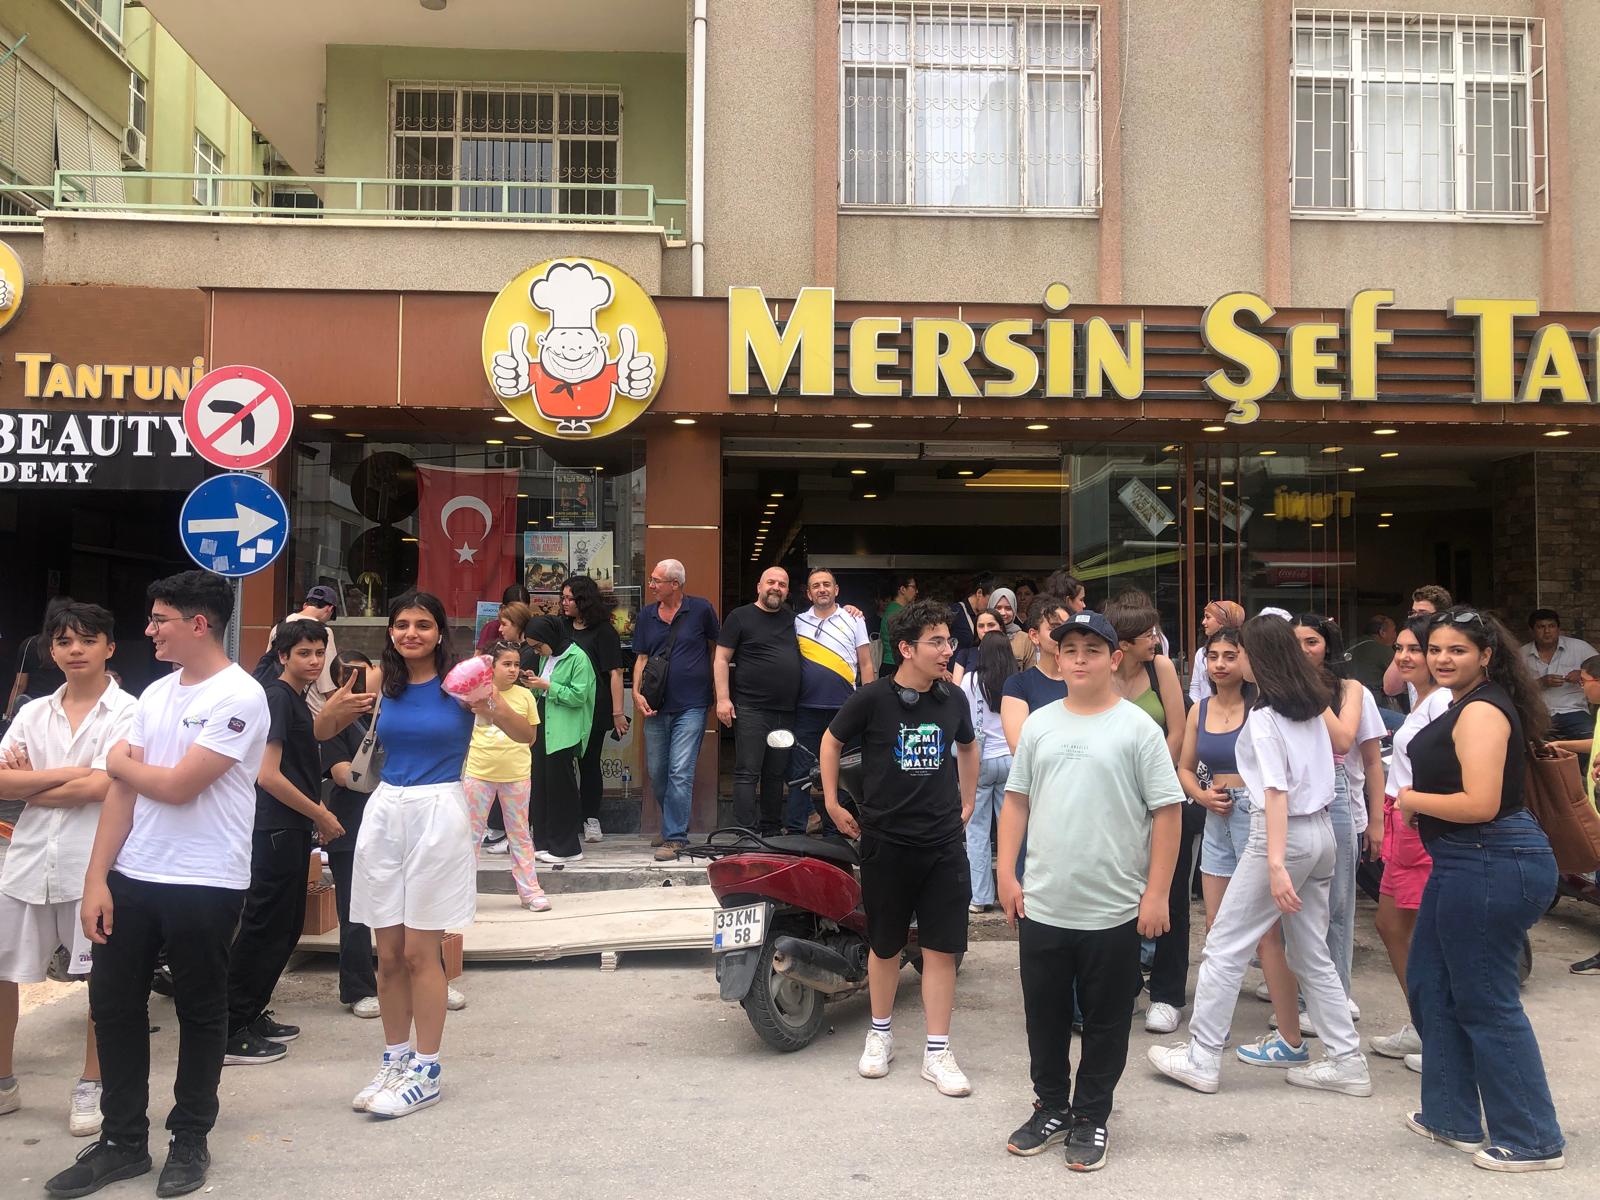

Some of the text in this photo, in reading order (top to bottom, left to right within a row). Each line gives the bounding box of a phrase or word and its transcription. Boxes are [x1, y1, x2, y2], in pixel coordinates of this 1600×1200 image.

[1447, 297, 1600, 404] TA
[908, 734, 935, 743] SEMI
[906, 746, 938, 756] AUTO
[903, 758, 940, 767] MATIC
[734, 927, 751, 944] 58
